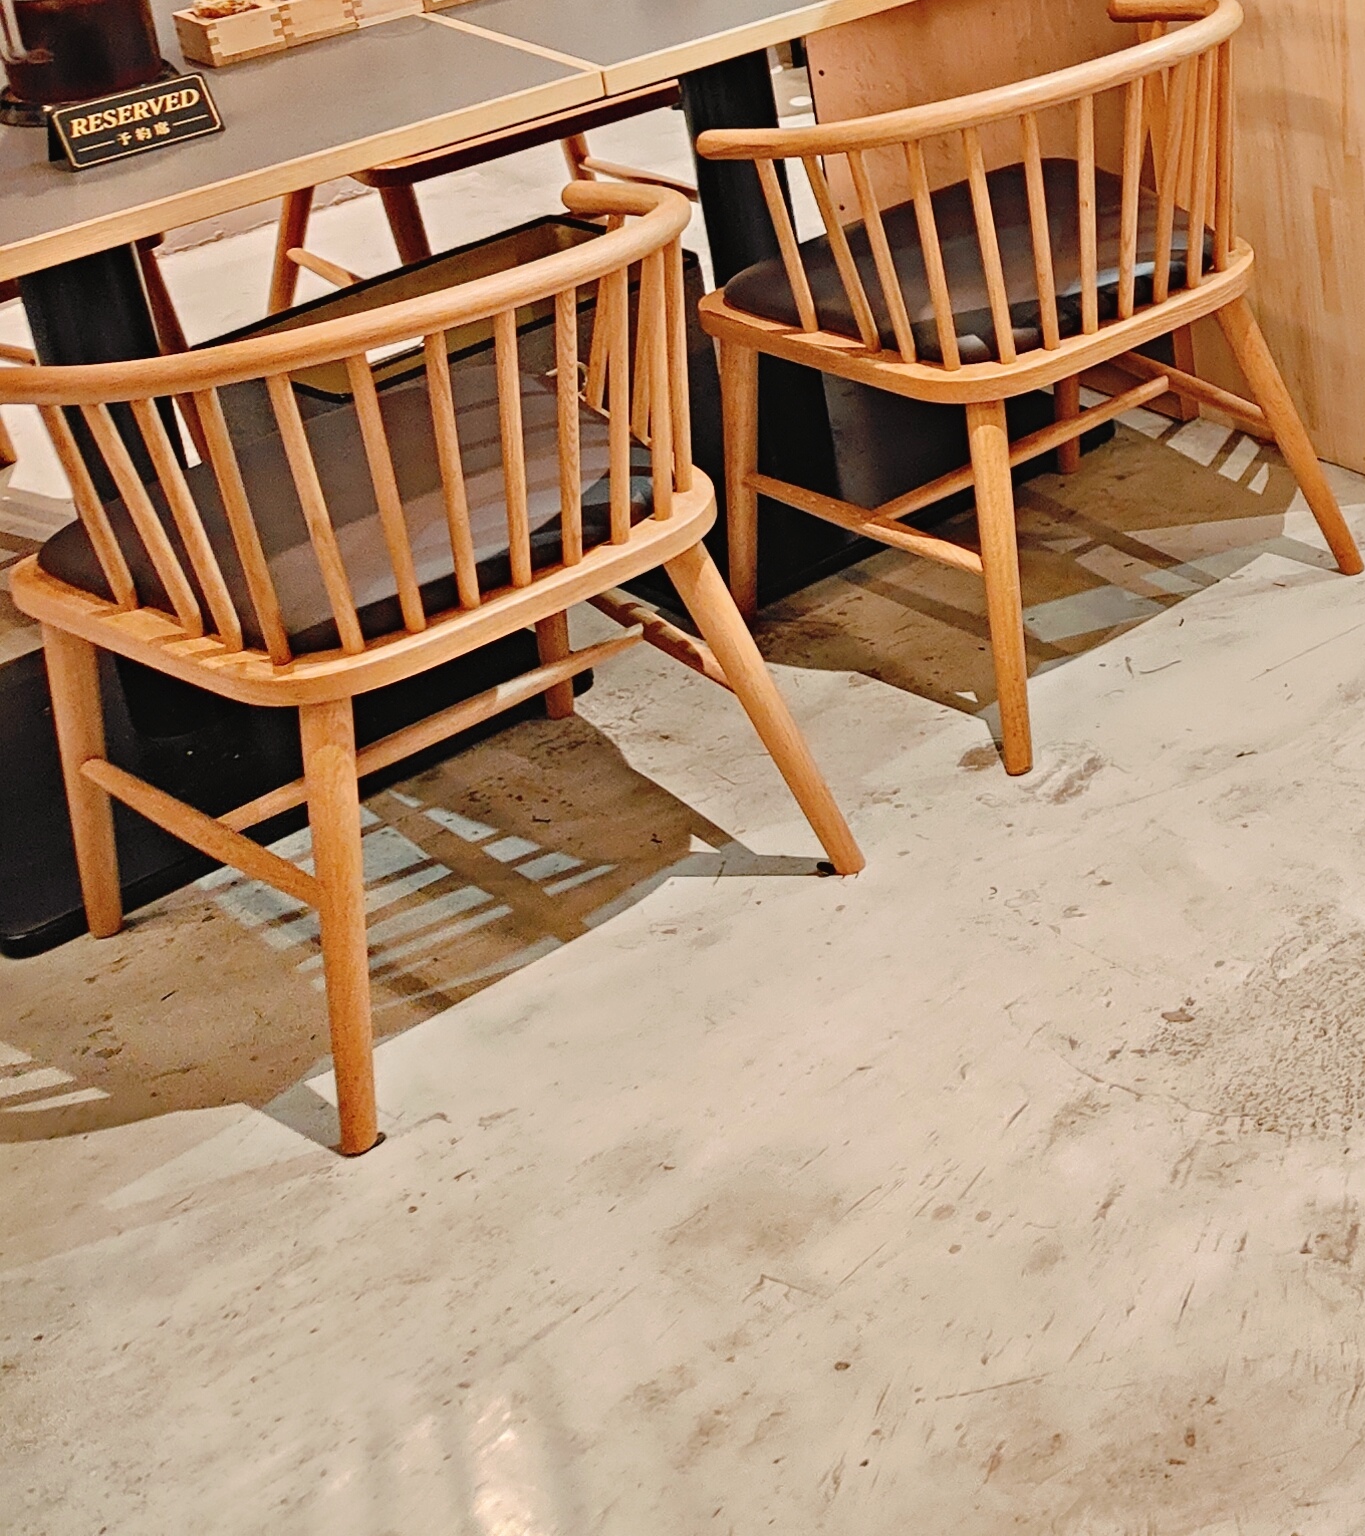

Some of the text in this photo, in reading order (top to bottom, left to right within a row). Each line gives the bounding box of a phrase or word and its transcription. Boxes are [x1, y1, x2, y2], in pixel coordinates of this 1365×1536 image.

[69, 88, 200, 139] RESERVED
[116, 121, 171, 146] 予約席
